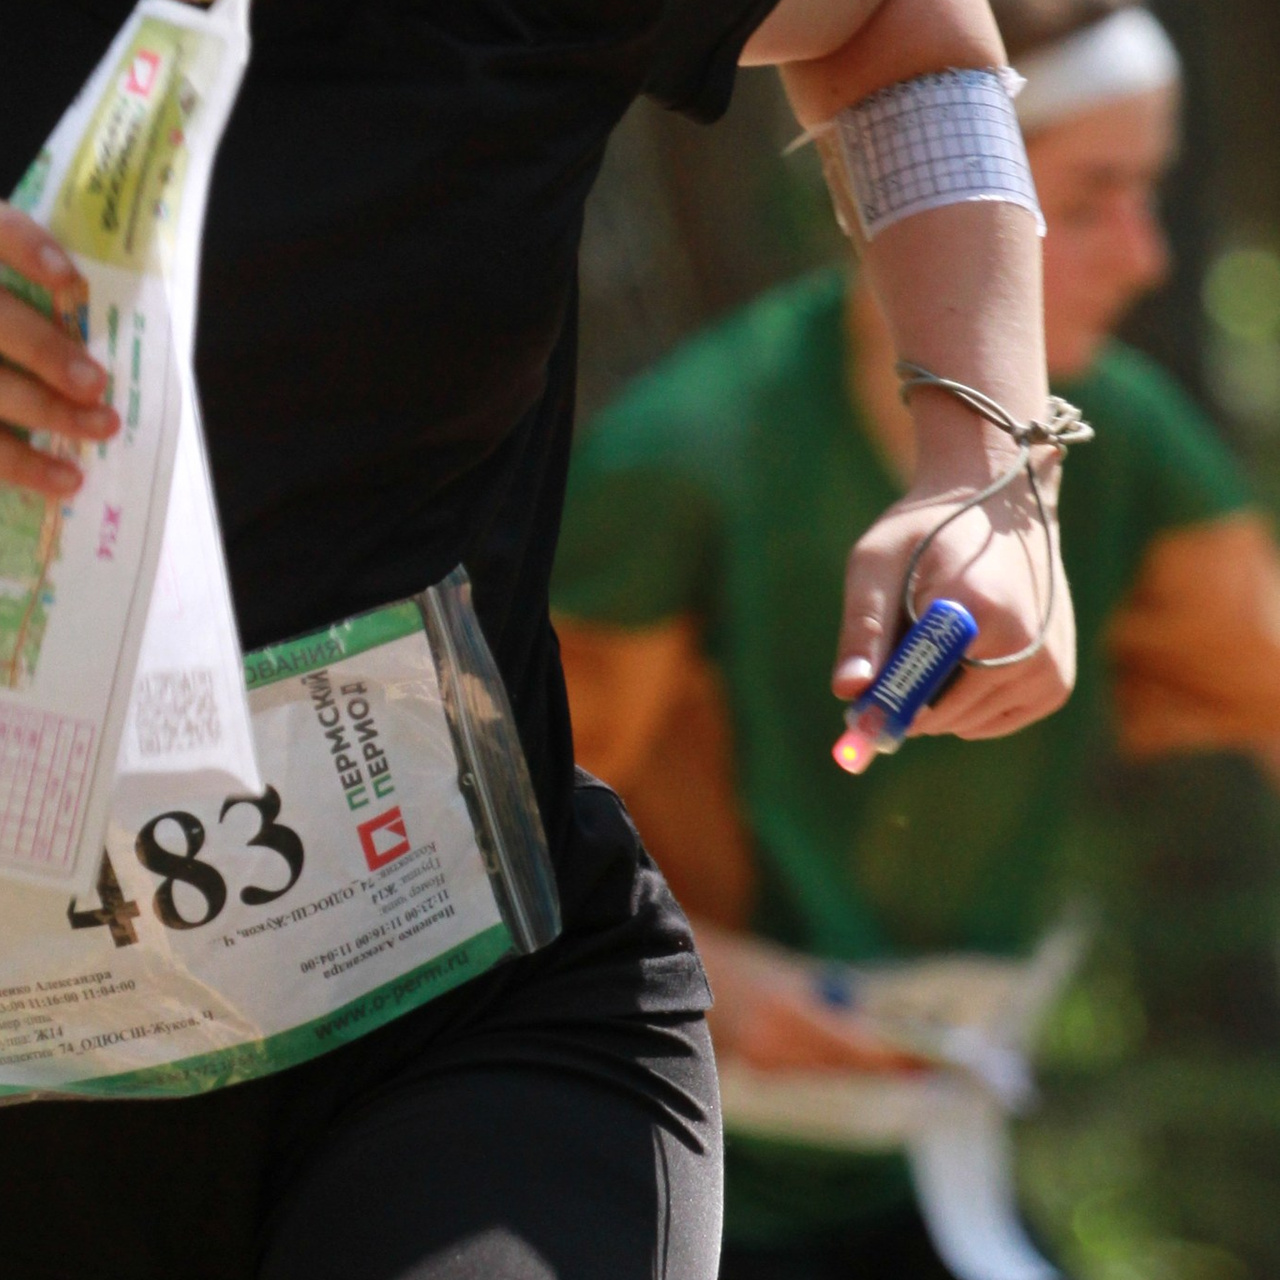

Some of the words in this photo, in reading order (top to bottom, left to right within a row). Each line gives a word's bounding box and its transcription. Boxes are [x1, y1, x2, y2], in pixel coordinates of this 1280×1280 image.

[301, 669, 369, 811] ПЕРМСКИЙ
[340, 681, 395, 799] ПЕРИОД
[67, 783, 304, 948] 483
[372, 882, 398, 905] Ж14
[405, 889, 450, 922] 11:23:00
[356, 916, 402, 948] 11:16:00
[399, 904, 456, 941] Иваненко
[300, 942, 352, 974] 11:04:00
[323, 941, 395, 980] Александра
[35, 971, 112, 991] Александра
[82, 979, 136, 1001] 11:04:00
[314, 950, 469, 1040] www.o-perm.ru
[33, 1026, 64, 1042] Ж14
